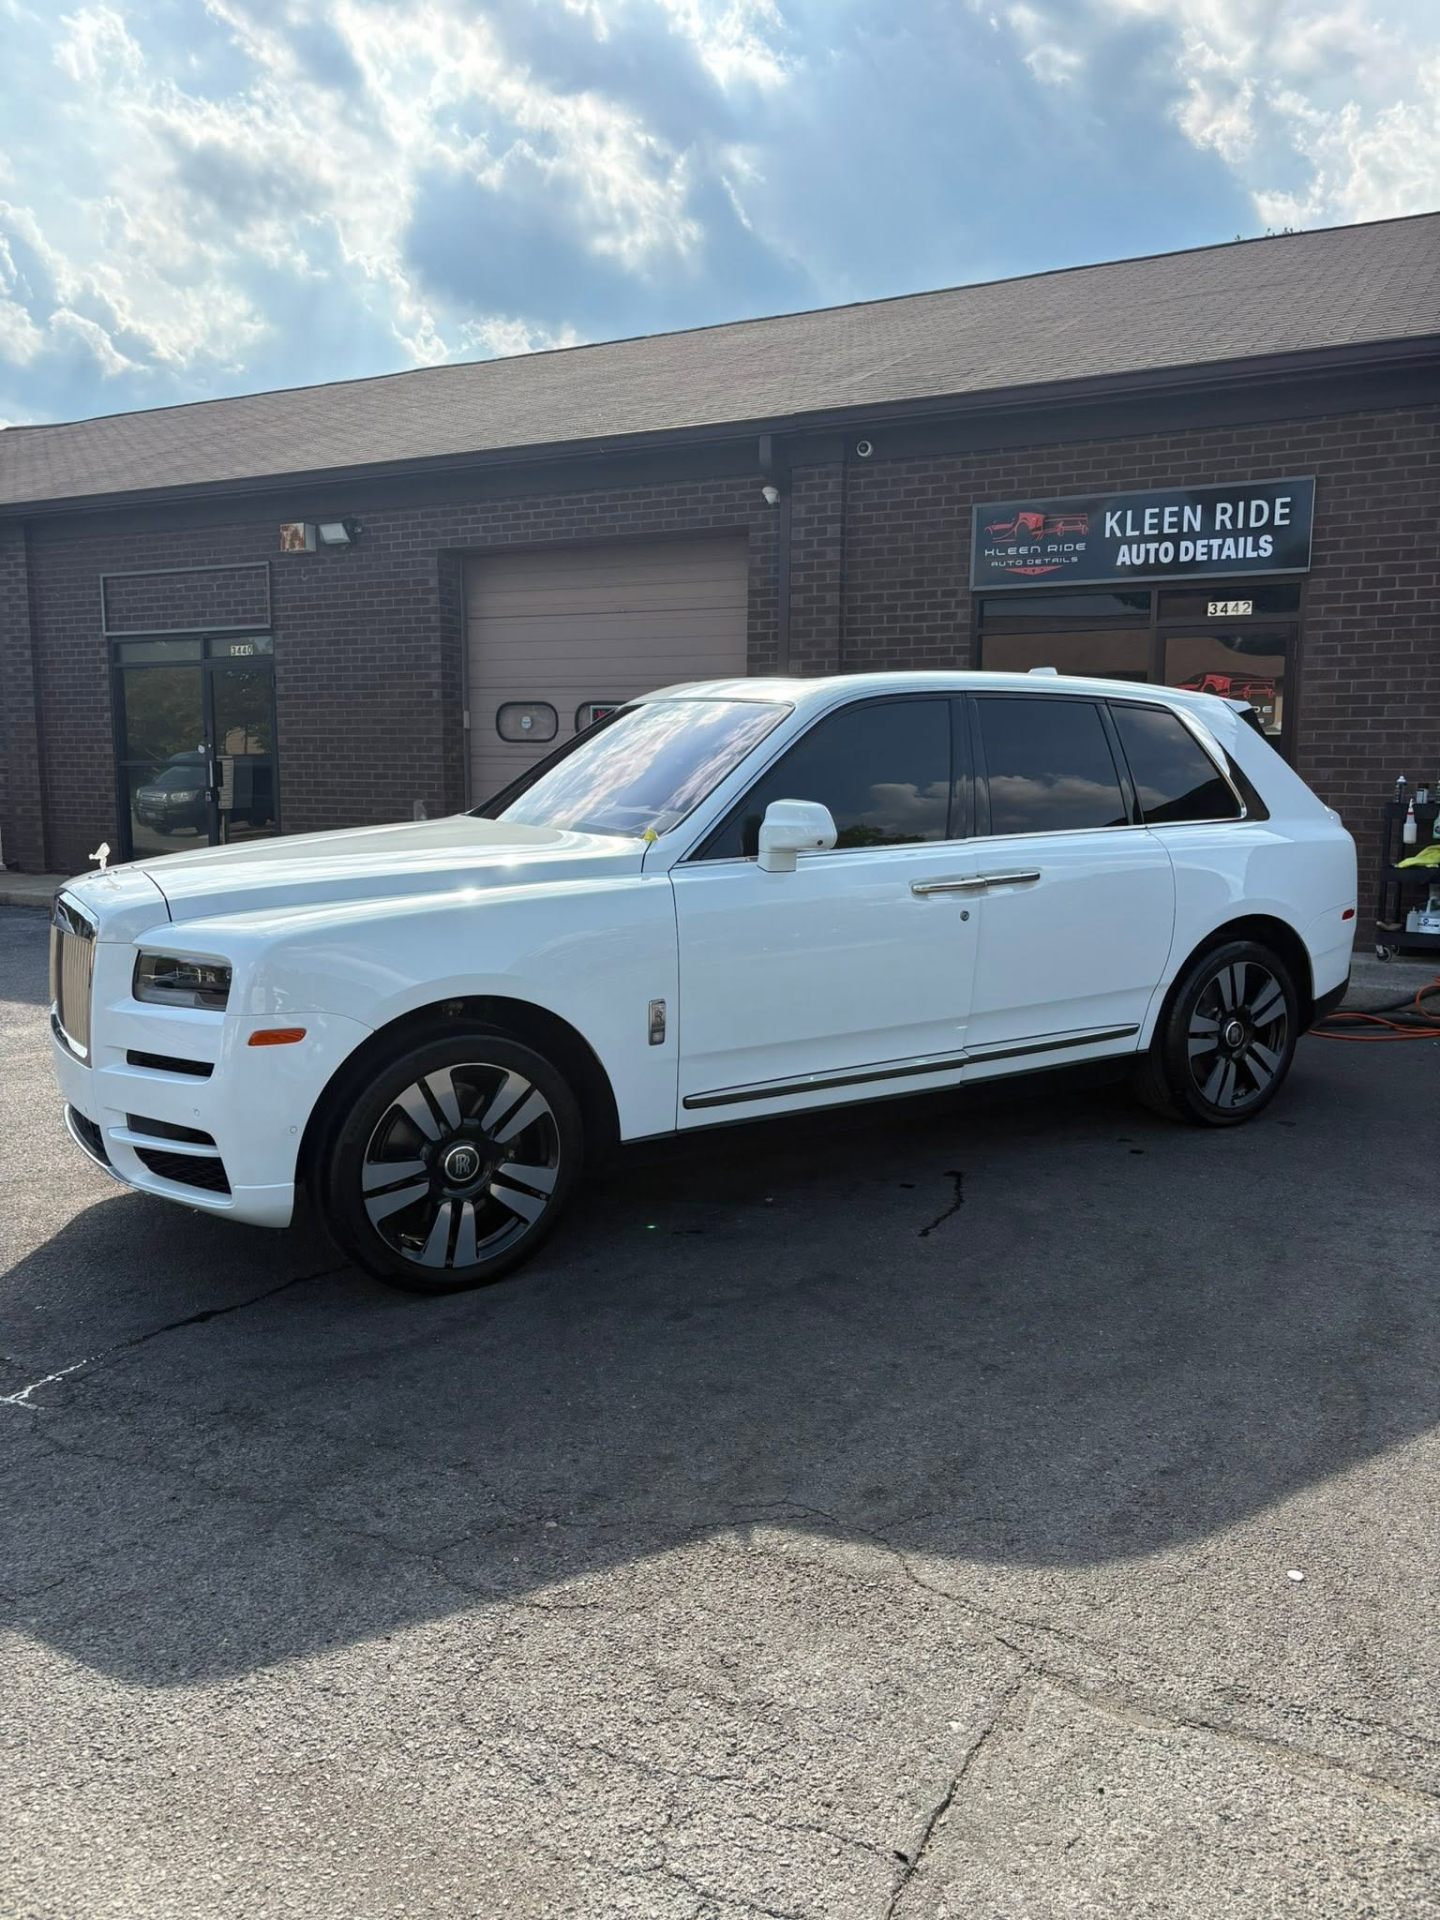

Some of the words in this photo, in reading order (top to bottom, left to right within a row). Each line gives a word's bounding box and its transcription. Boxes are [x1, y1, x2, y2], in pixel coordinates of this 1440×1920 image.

[1104, 505, 1202, 538] KLEEN
[1215, 497, 1291, 531] RIDE
[1047, 542, 1087, 553] RIDE
[1115, 541, 1174, 566] AUTO
[1179, 534, 1273, 562] DETAILS
[990, 558, 1023, 567] AUTO
[1026, 555, 1079, 565] DETAILS
[1208, 601, 1251, 616] 3442
